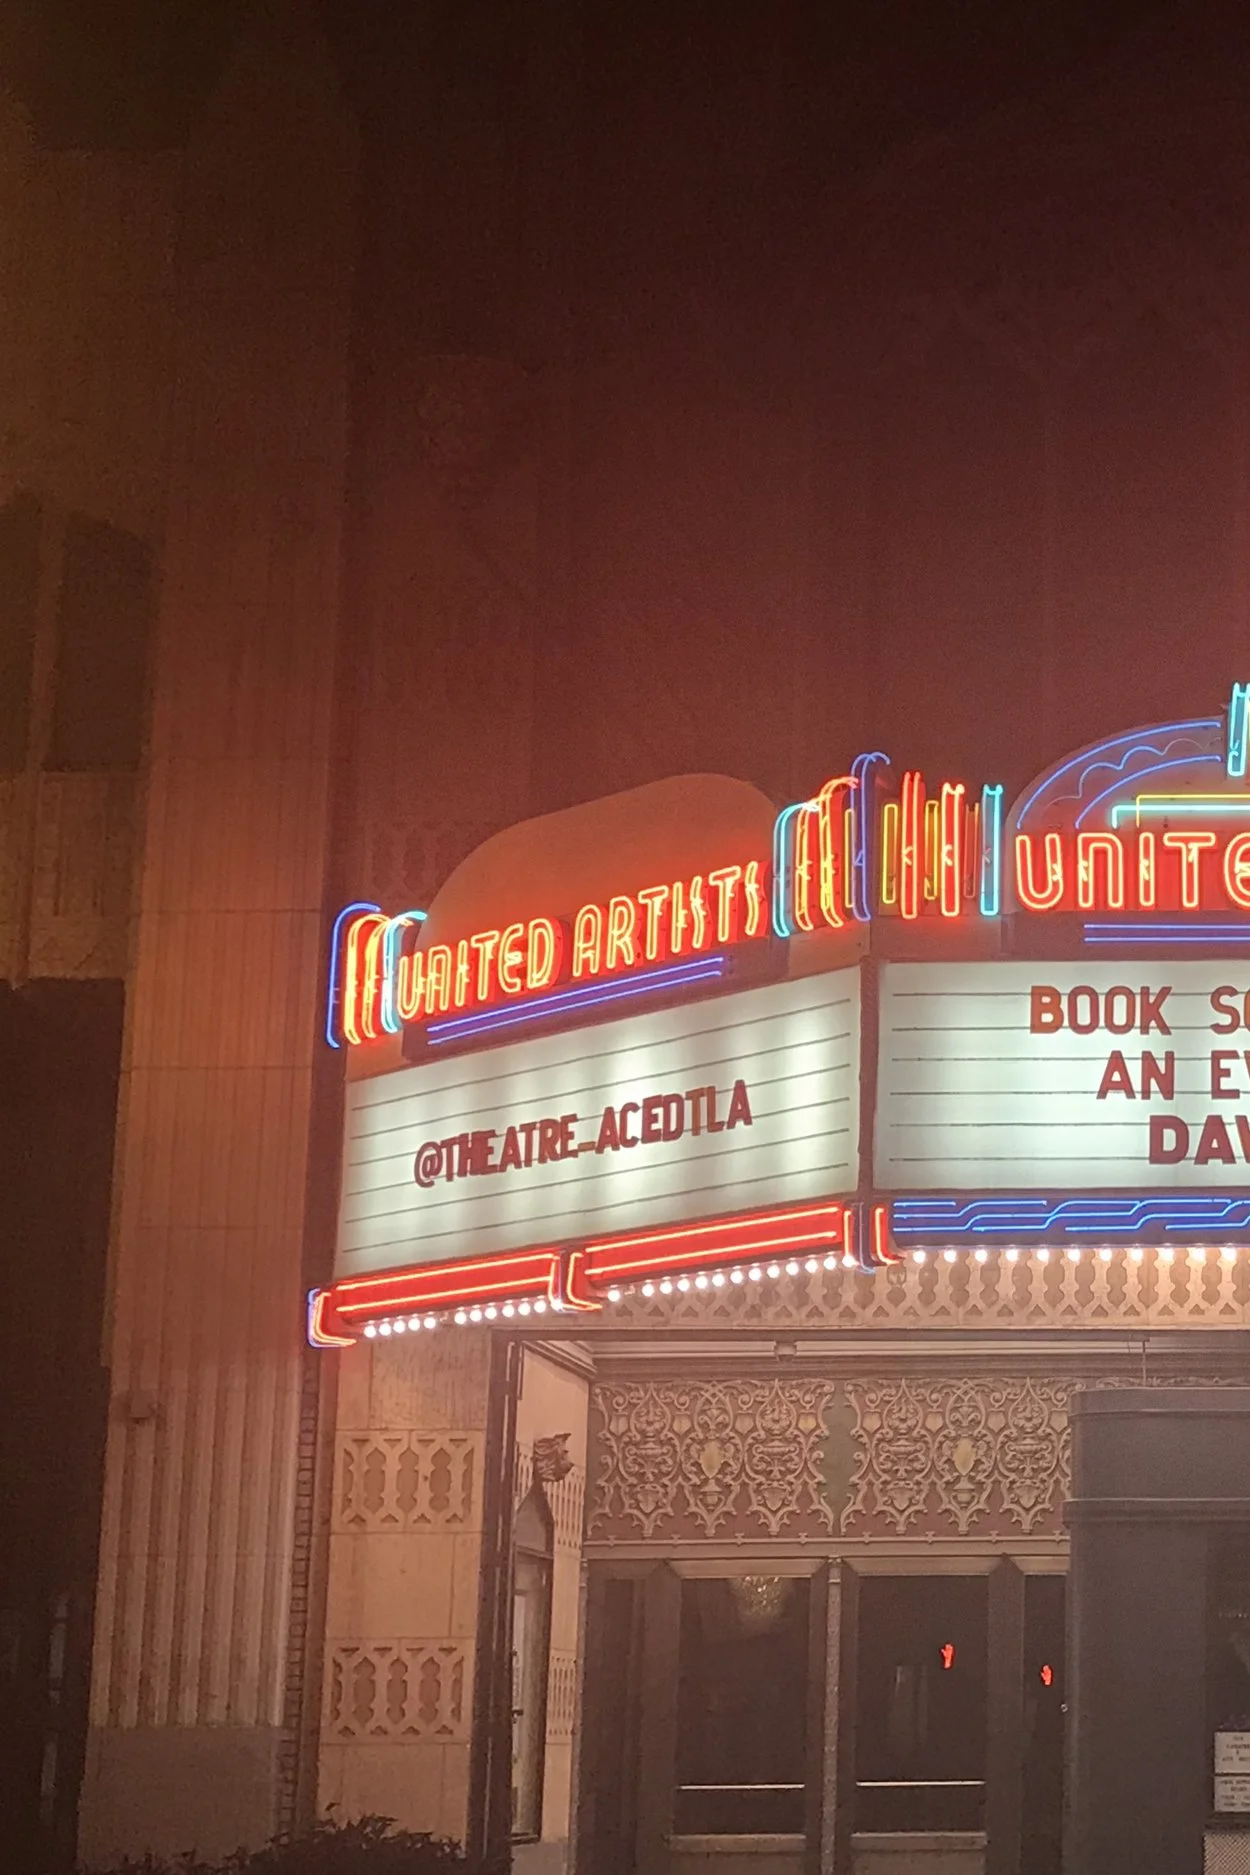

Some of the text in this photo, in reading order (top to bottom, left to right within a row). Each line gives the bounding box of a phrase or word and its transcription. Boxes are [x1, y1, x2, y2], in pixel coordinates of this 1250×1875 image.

[396, 860, 760, 1020] UNITED ARTISTS
[1029, 984, 1173, 1036] BOOK
[1096, 1049, 1175, 1101] AN
